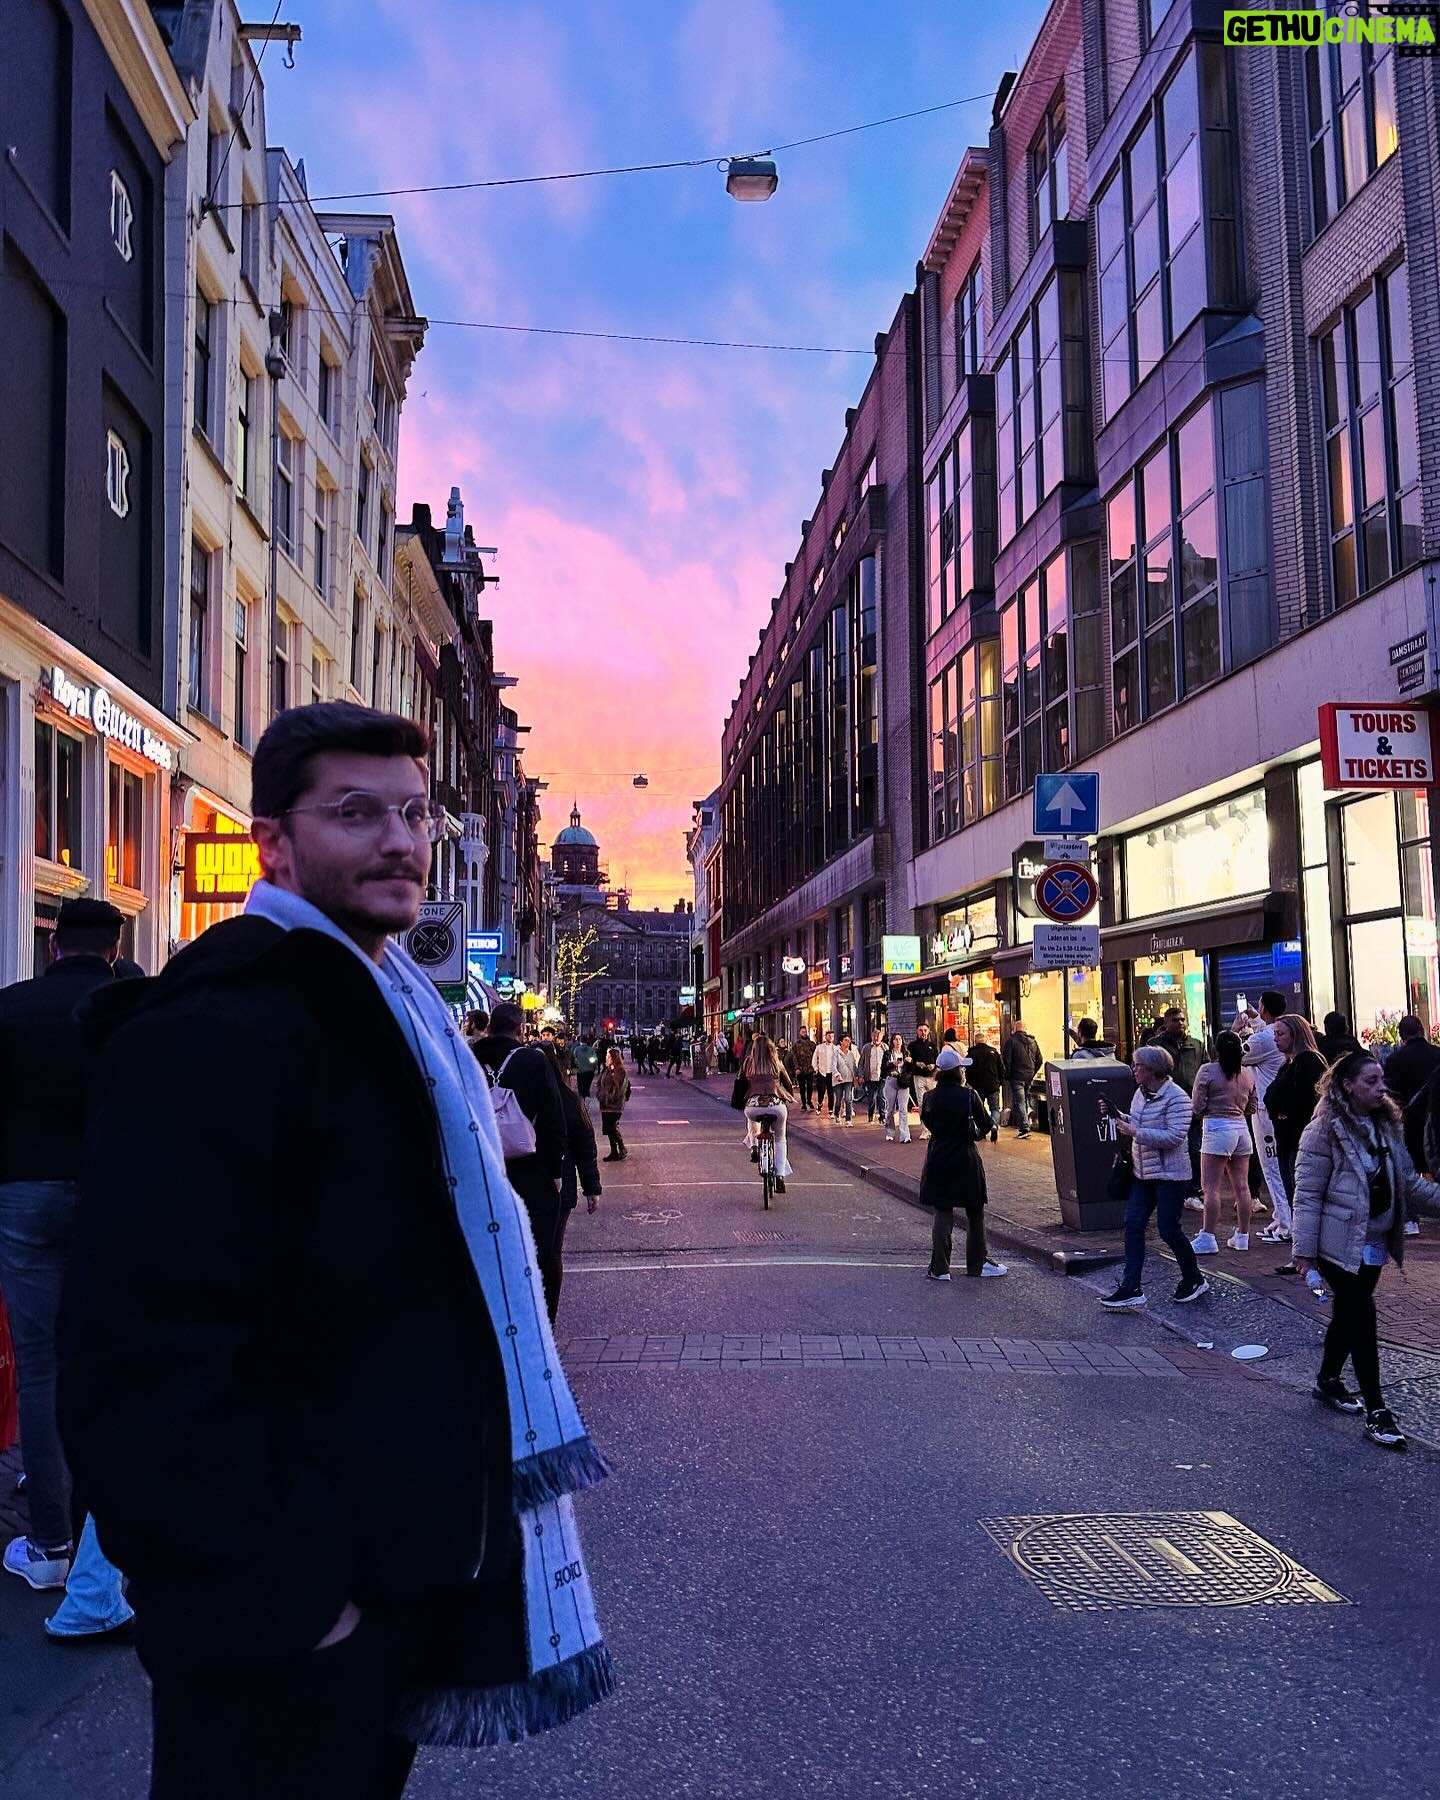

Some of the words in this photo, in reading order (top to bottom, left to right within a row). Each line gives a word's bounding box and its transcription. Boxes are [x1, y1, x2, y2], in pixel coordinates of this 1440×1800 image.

[52, 666, 91, 718] Royal
[93, 688, 142, 753] Queen
[1349, 713, 1417, 734] TOURS
[1376, 736, 1393, 756] &
[1344, 758, 1428, 779] TICKETS
[195, 843, 261, 875] WOK
[195, 874, 216, 893] TO
[891, 962, 915, 971] ATM
